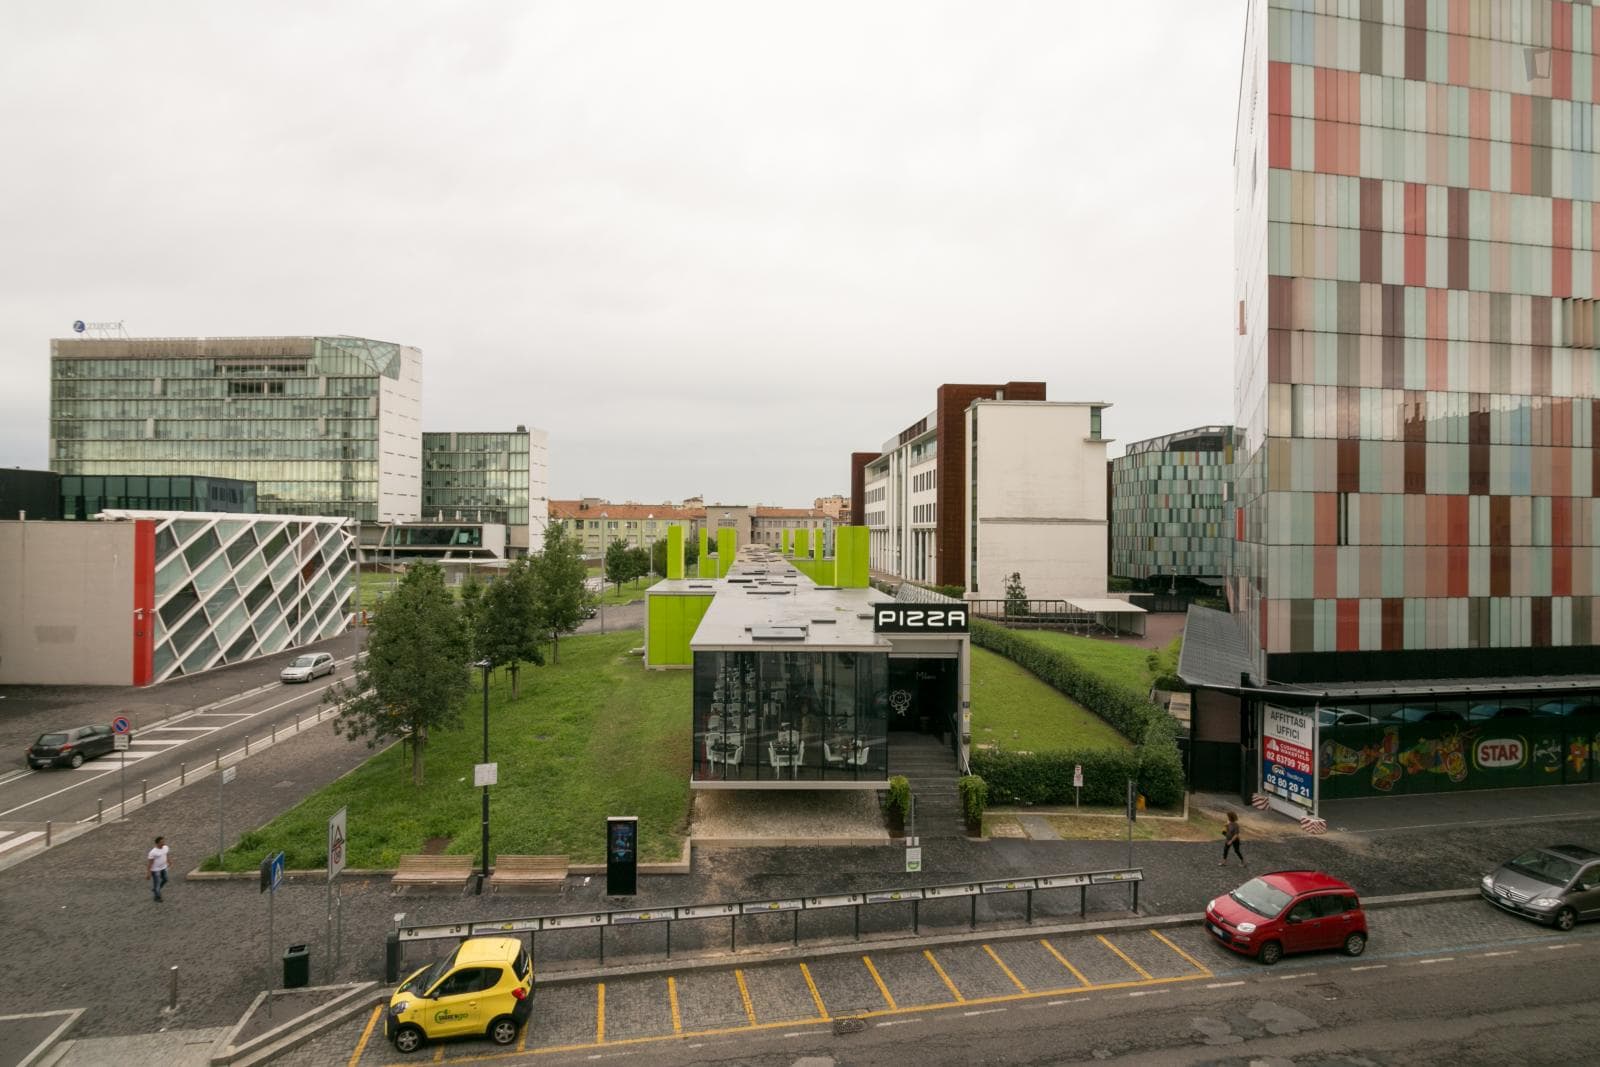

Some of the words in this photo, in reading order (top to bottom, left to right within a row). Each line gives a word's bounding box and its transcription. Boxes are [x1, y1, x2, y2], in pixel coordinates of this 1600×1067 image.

[879, 611, 965, 626] PIZZA
[1270, 711, 1306, 728] AFFITTASI
[1276, 724, 1300, 739] UFFICI
[1481, 744, 1519, 761] STAR
[1266, 774, 1276, 784] 02
[1300, 787, 1310, 797] 21
